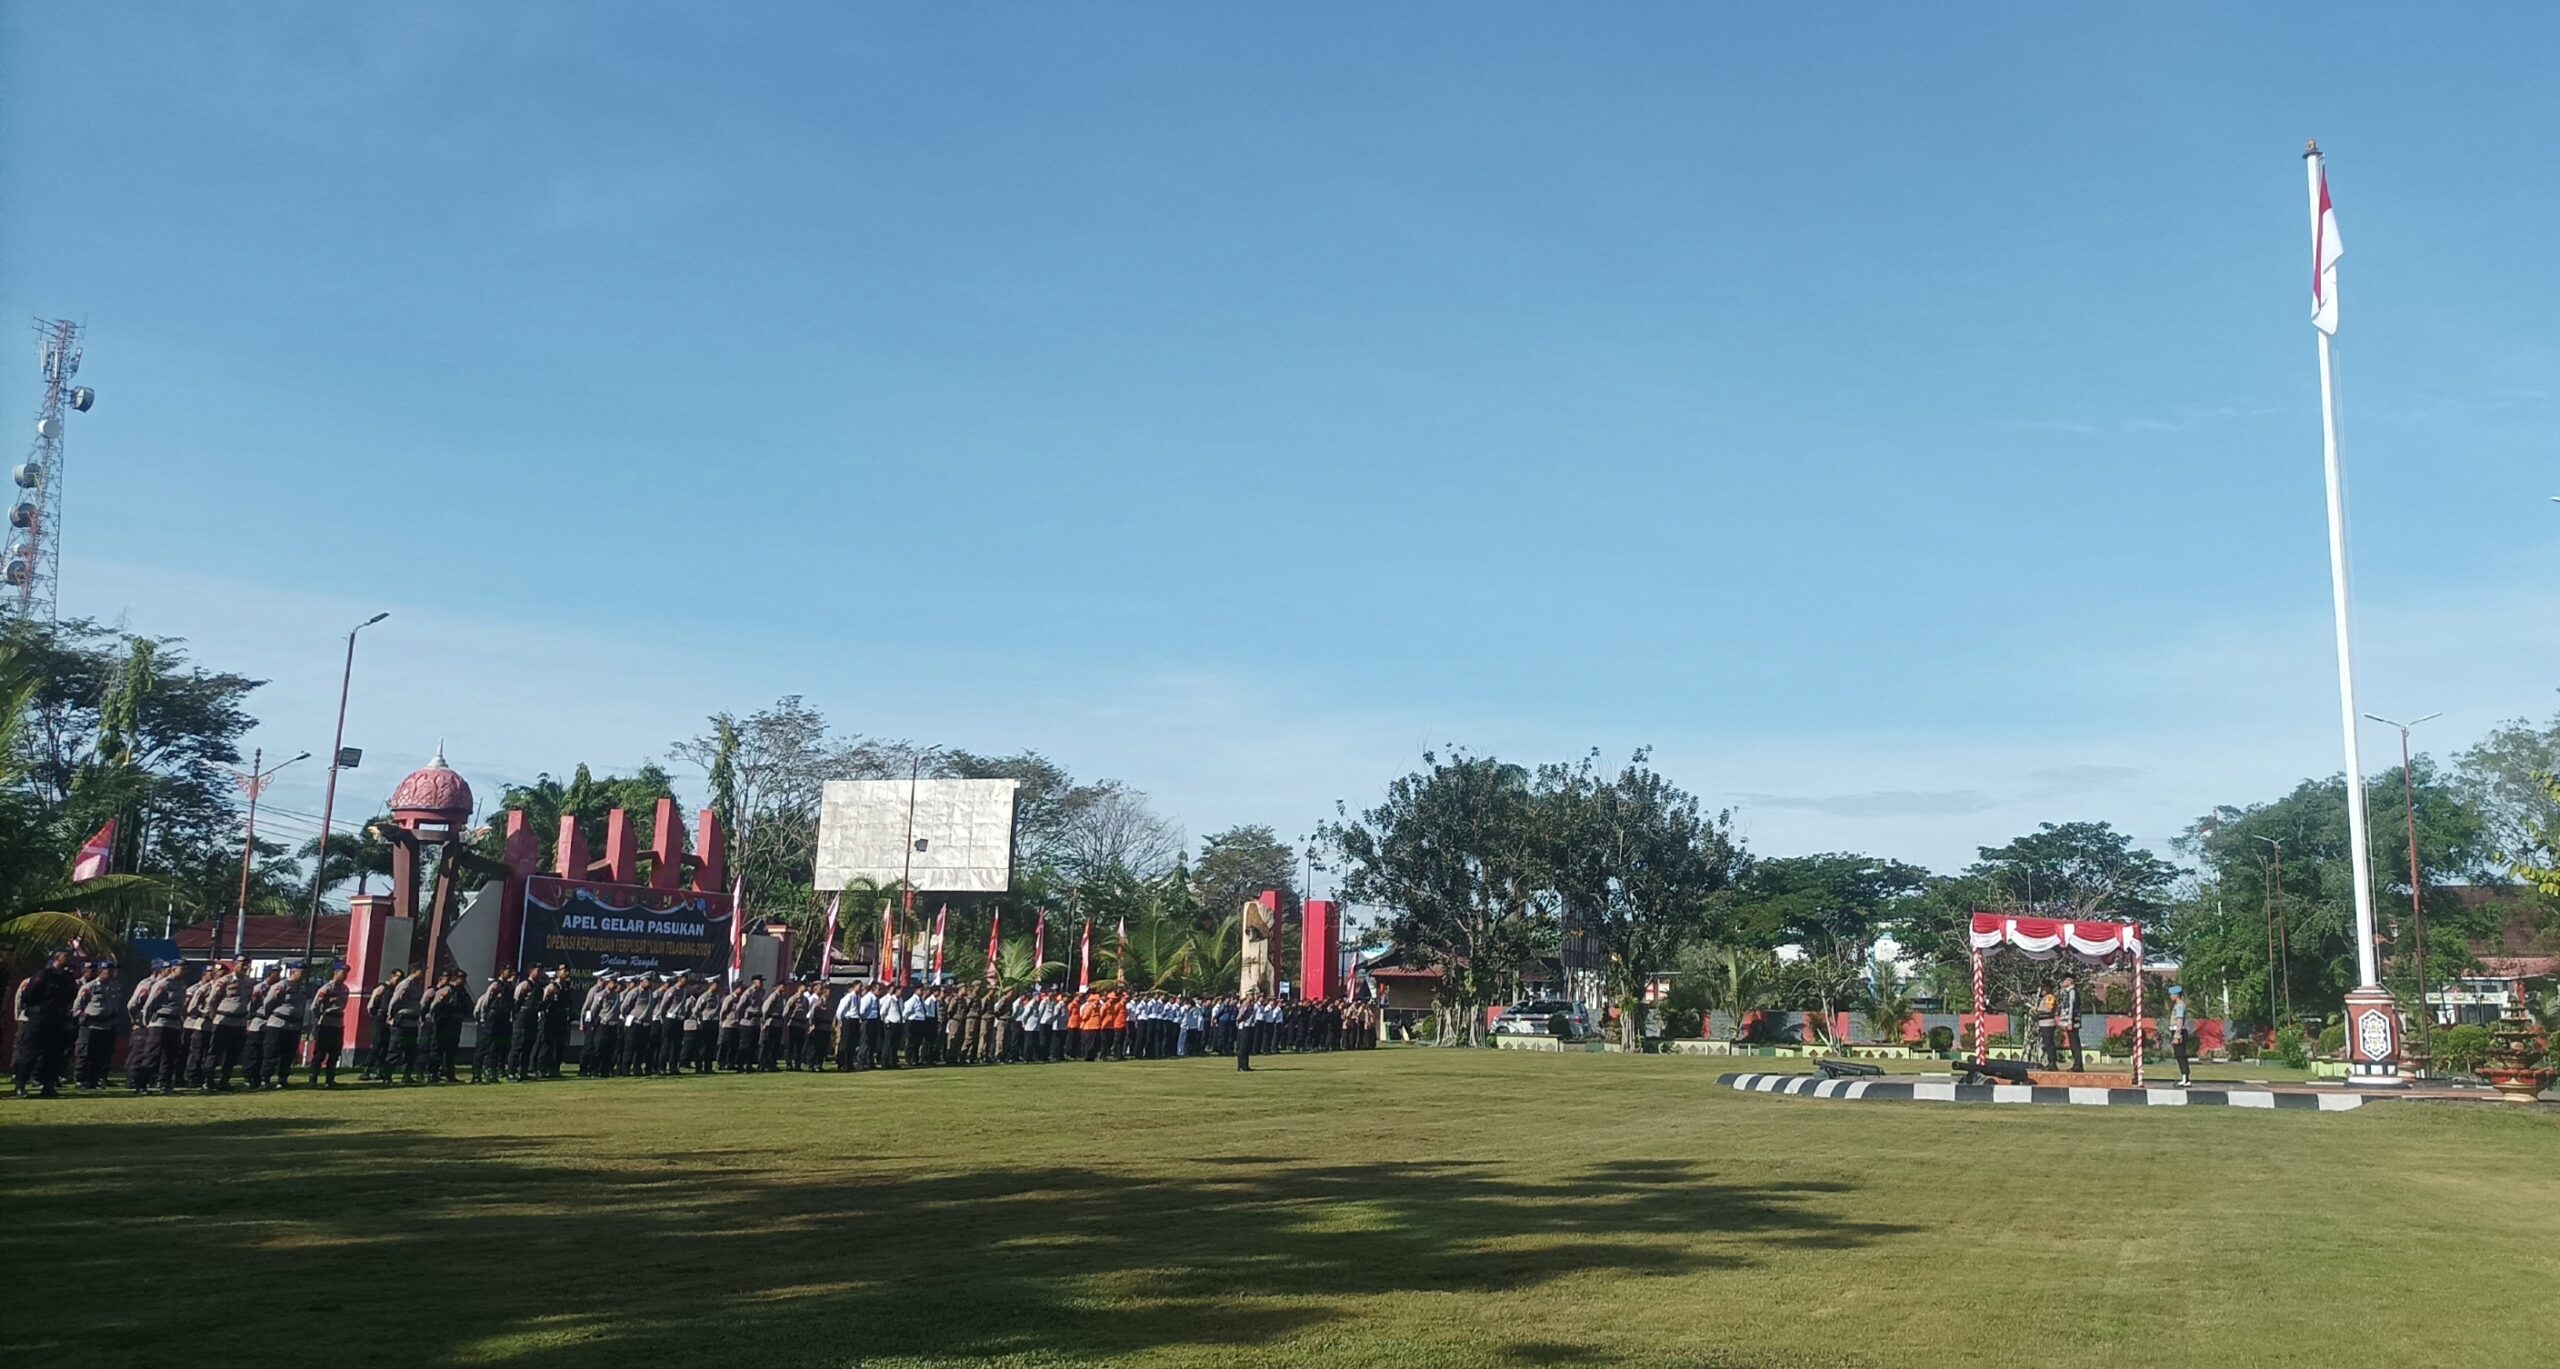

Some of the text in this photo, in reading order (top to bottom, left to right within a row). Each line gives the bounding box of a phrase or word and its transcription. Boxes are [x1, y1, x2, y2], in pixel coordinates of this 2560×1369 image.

[562, 914, 705, 937] APEL GELAR PASUKAN
[546, 934, 576, 950] OPERASI
[576, 936, 614, 952] KEPOLISIAN
[616, 938, 647, 954] TERPUSAT
[600, 954, 659, 969] Dalam Rangka
